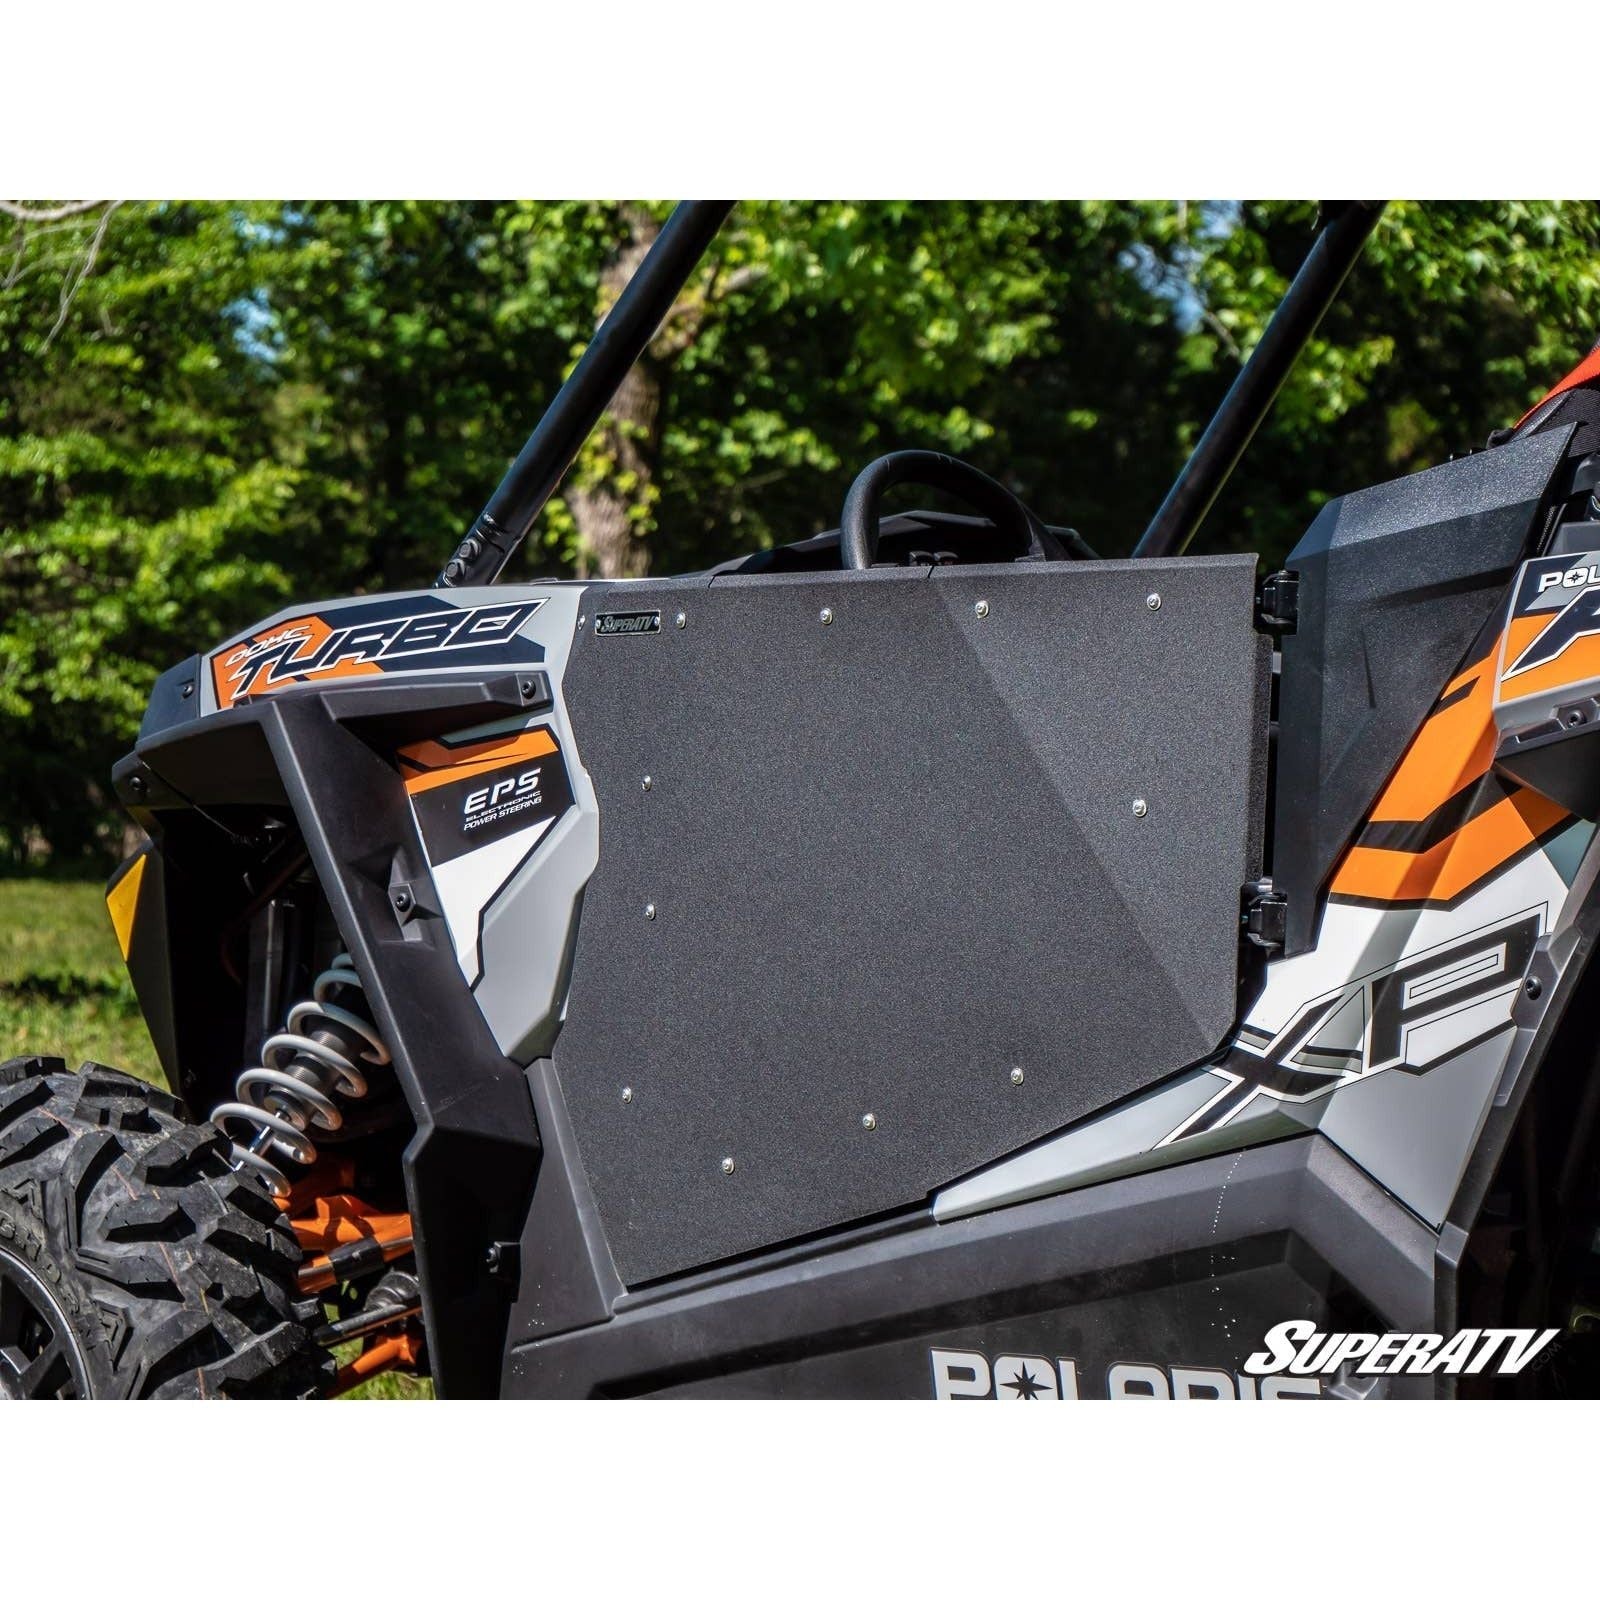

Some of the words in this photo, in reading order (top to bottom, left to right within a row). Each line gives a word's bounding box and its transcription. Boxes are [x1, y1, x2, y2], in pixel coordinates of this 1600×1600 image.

[228, 597, 550, 700] TURBO
[464, 768, 541, 814] EPS
[465, 790, 541, 823] ELECTRONIC
[463, 812, 498, 831] POWER
[498, 795, 543, 818] STEERING
